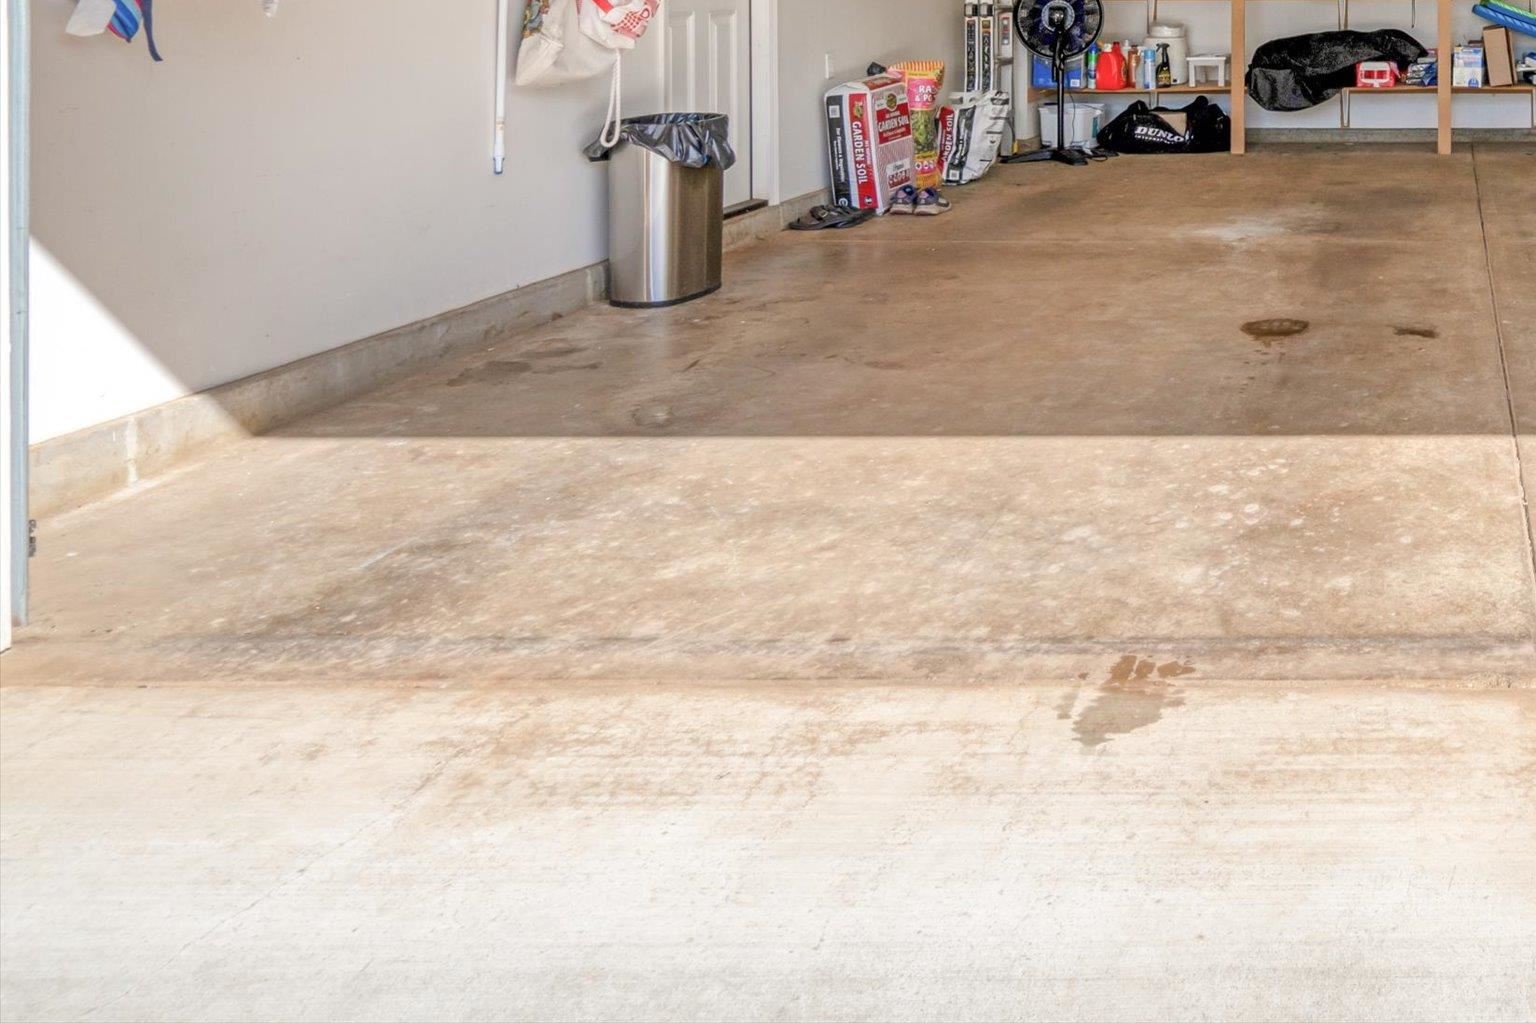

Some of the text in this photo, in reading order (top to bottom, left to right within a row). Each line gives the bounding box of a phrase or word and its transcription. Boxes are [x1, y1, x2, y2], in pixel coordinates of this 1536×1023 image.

[946, 113, 954, 132] SOIL
[852, 121, 868, 184] GARDEN SOIL
[942, 134, 952, 163] ARDEN
